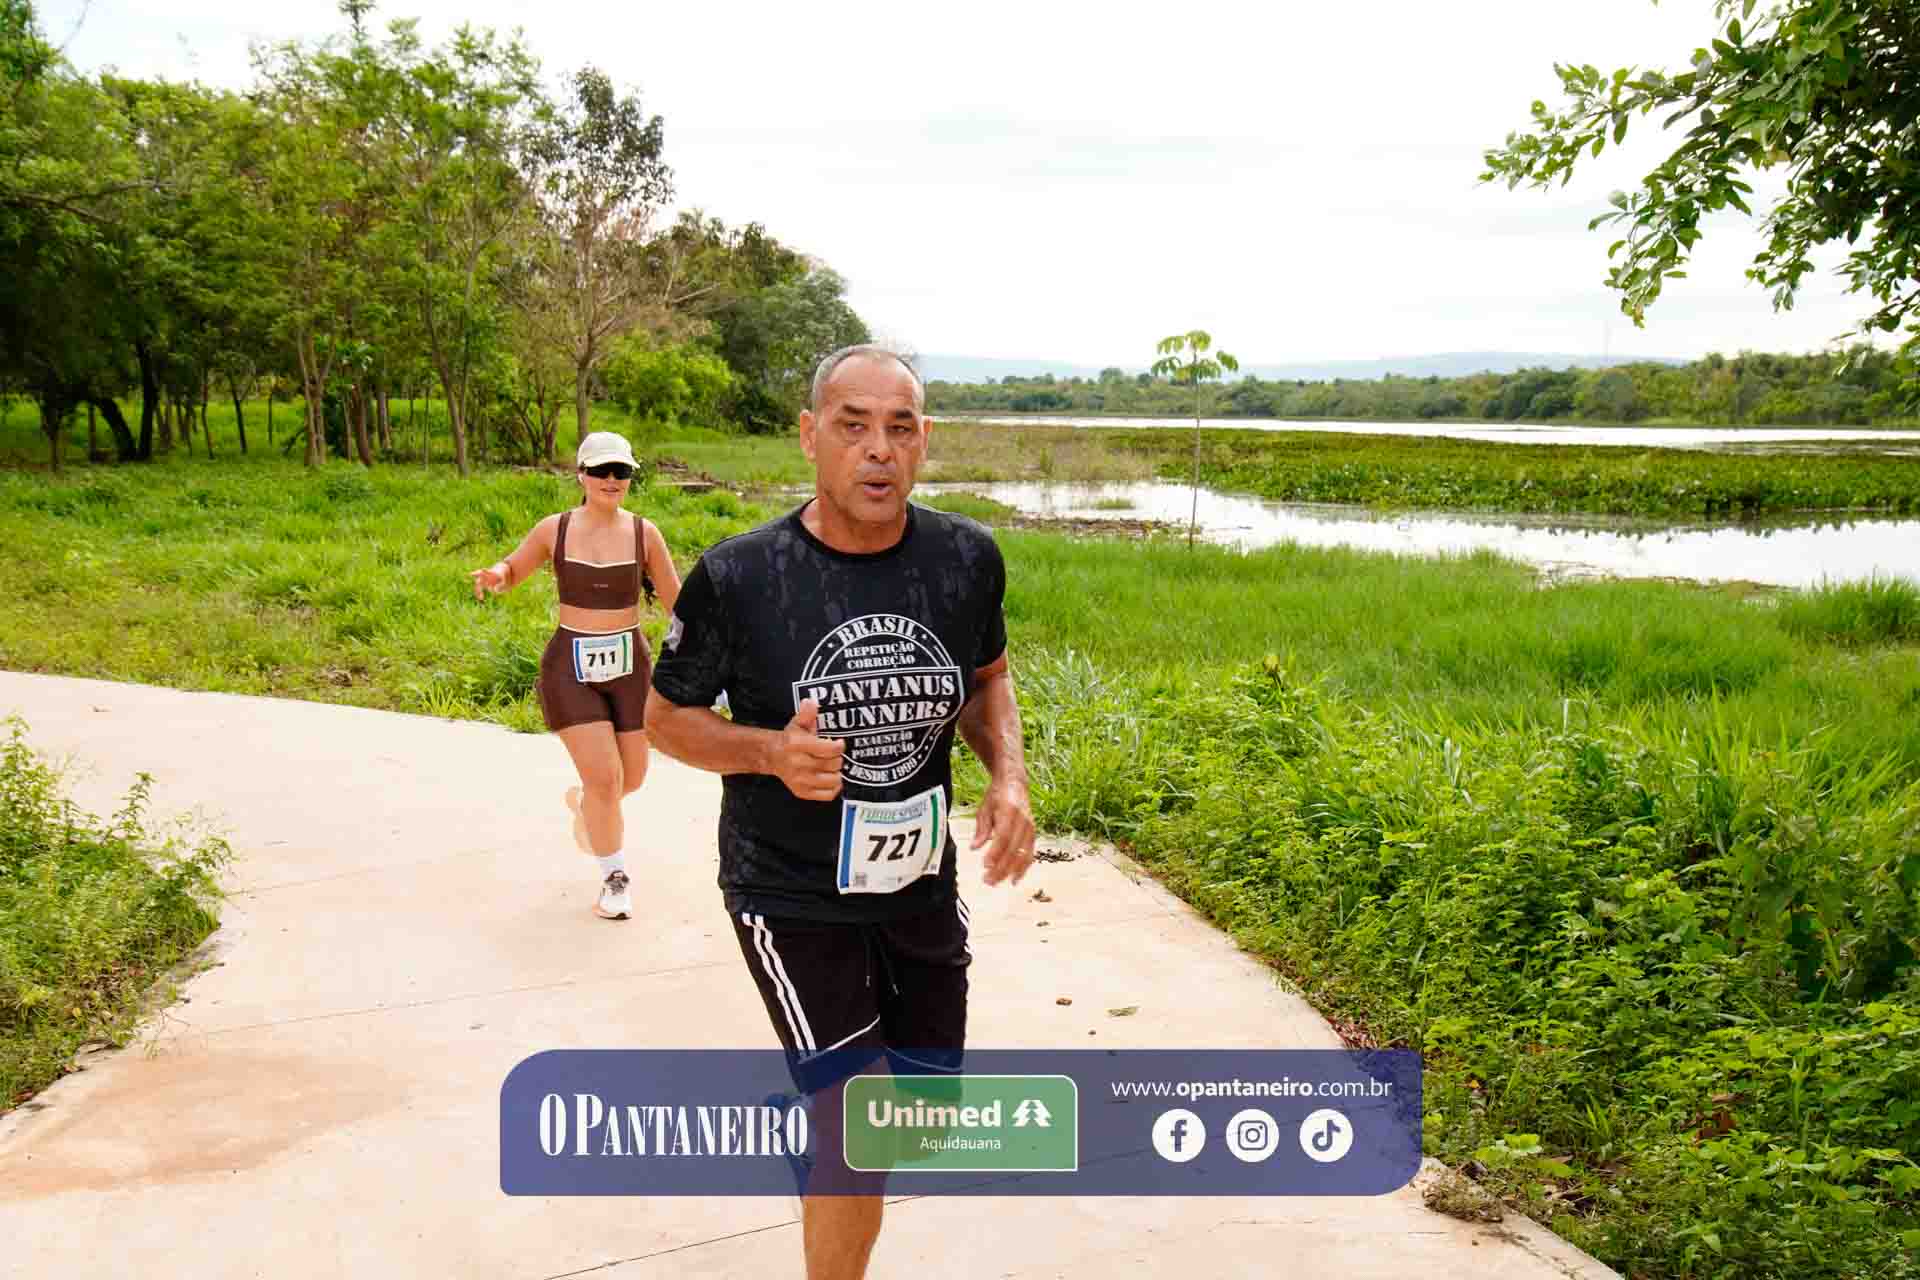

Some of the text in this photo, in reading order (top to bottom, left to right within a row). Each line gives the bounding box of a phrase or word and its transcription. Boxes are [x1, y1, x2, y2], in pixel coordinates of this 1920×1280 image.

[835, 616, 918, 646] BRASIL
[586, 650, 617, 667] 711
[844, 641, 916, 659] REPETIÇÃO
[847, 653, 916, 670] CORREÇÃO
[808, 674, 956, 708] PANTANUS
[816, 700, 950, 731] RUNNERS
[849, 764, 890, 783] DESDE
[867, 828, 922, 862] 727
